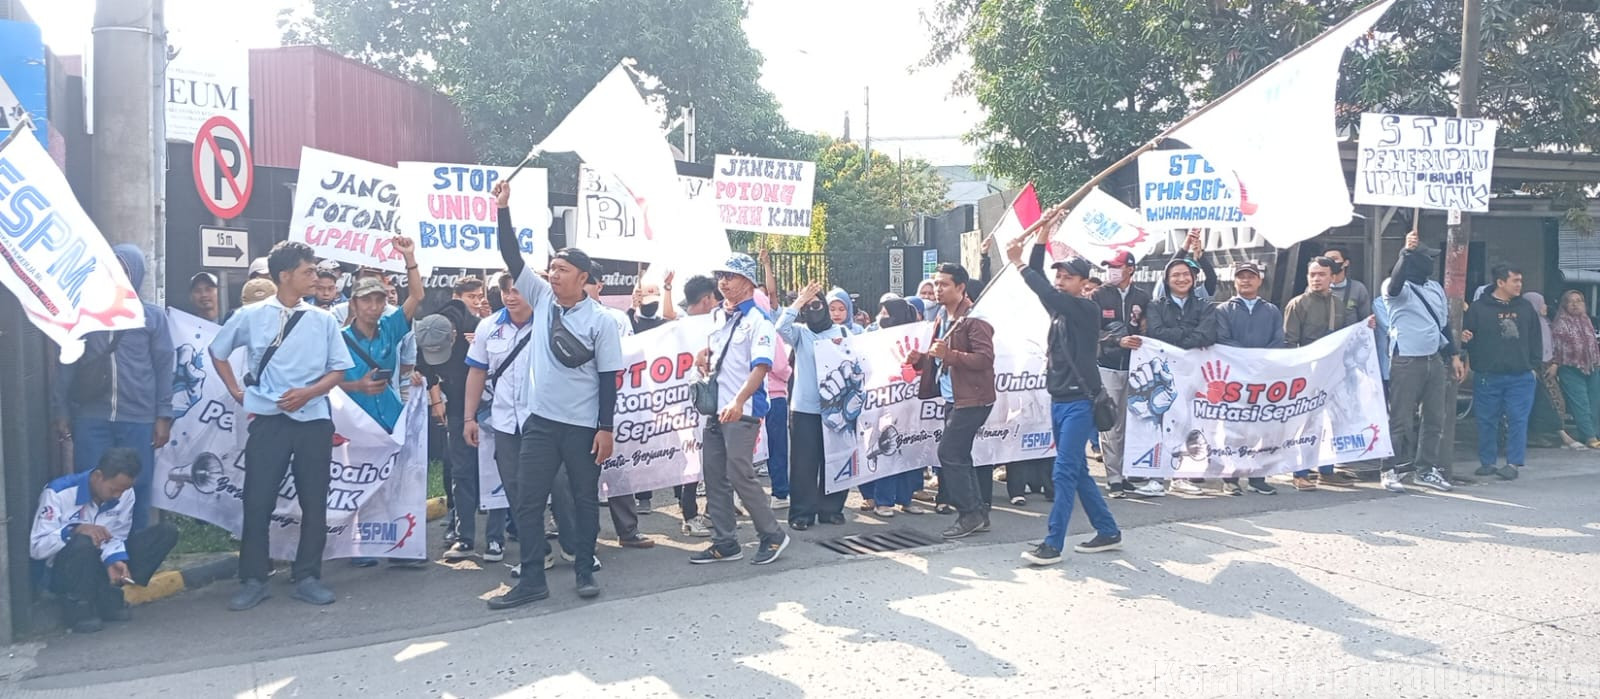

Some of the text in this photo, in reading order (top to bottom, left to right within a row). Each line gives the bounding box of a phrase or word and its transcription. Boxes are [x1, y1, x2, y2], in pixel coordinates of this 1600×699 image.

[1377, 115, 1485, 148] STOP
[320, 169, 401, 208] JANG
[432, 166, 500, 193] STOP
[1423, 183, 1488, 210] UMK
[767, 206, 812, 228] KAMI
[305, 224, 370, 255] UPAH
[418, 221, 534, 254] BUSTG
[614, 384, 691, 415] tongan
[1193, 389, 1328, 423] Mutasi Sepihak
[1223, 377, 1307, 405] STOP
[615, 406, 700, 444] Sepihak
